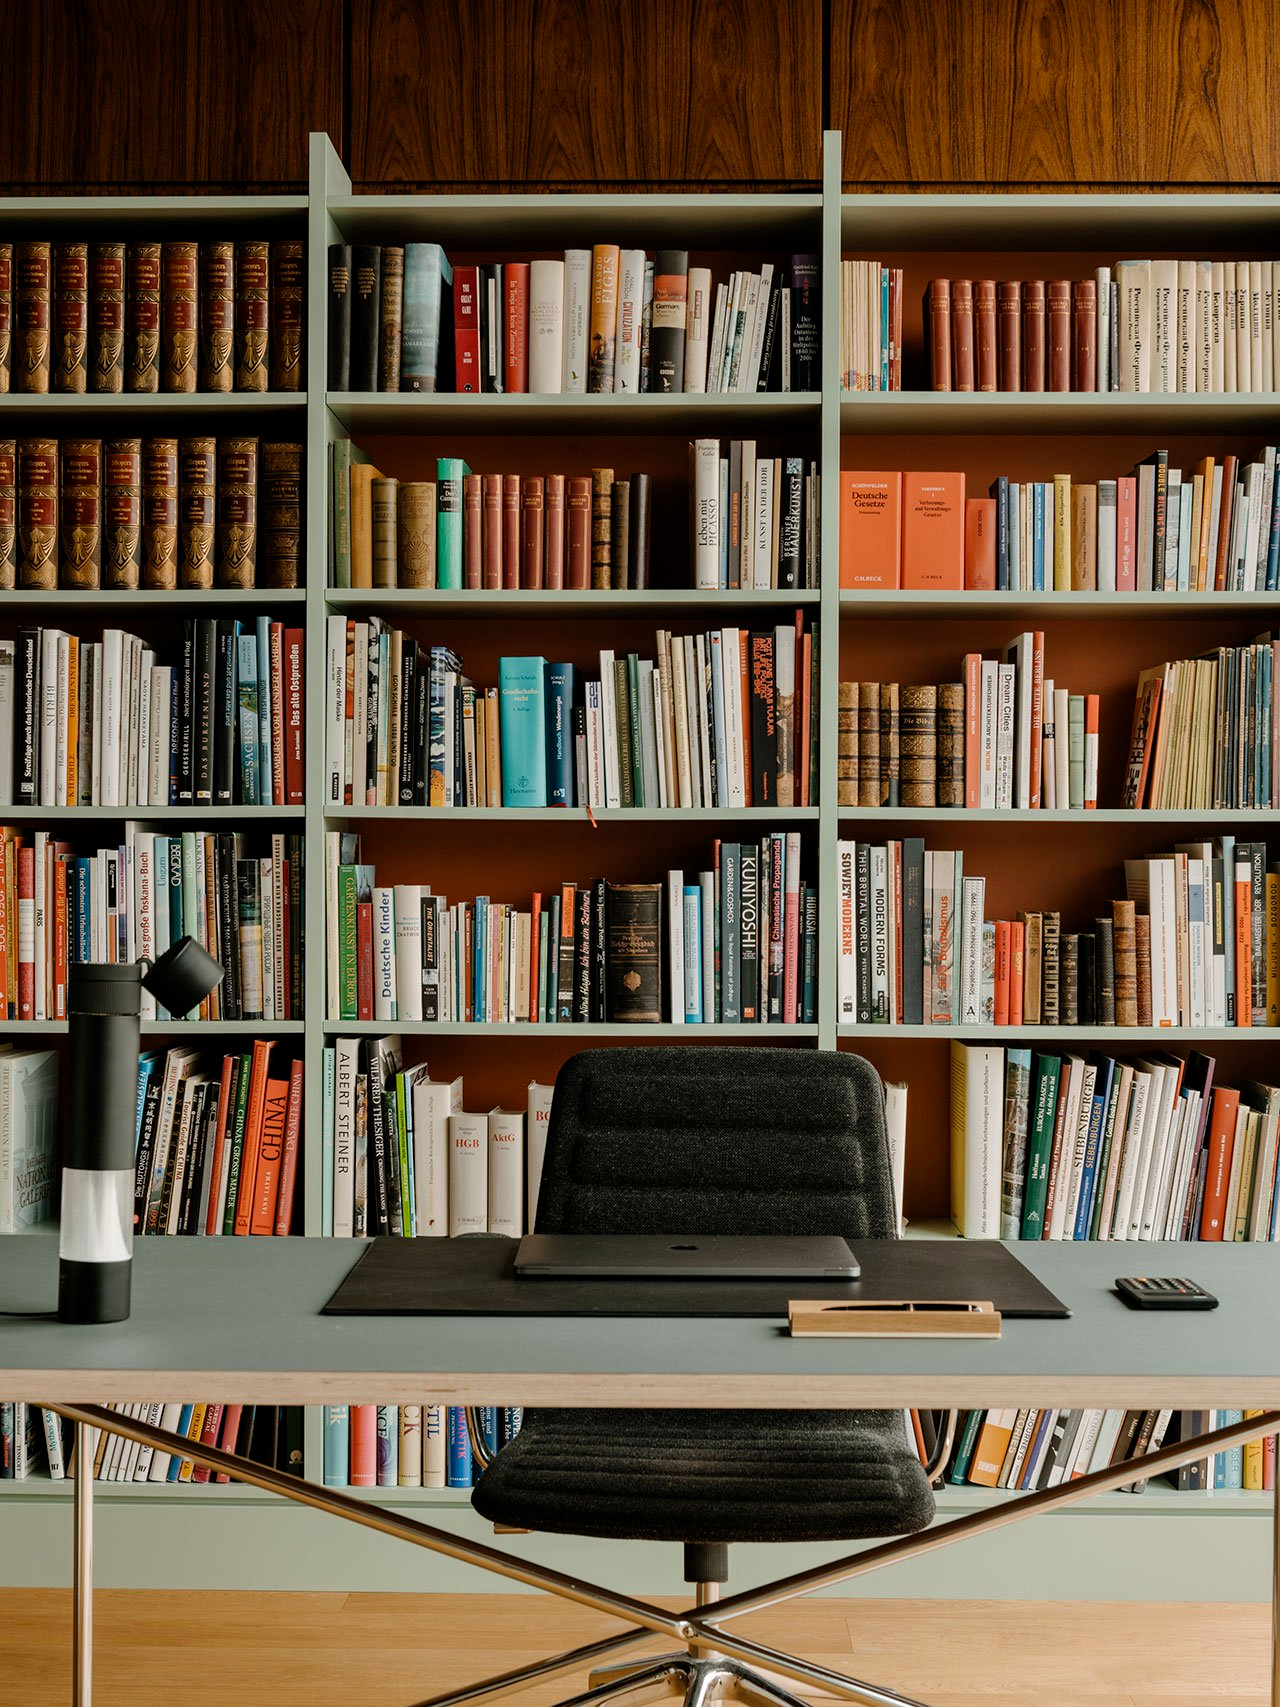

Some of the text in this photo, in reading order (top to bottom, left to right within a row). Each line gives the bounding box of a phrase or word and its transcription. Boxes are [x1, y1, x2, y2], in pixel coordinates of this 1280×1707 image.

[508, 289, 517, 305] Troja
[602, 256, 615, 303] FIGES
[622, 302, 633, 343] CIVILIZATION
[1212, 292, 1221, 343] Белоруссия
[1133, 341, 1142, 392] Федерация
[699, 517, 708, 546] Leben
[708, 499, 717, 546] PICASSO
[760, 508, 766, 518] IN
[790, 476, 801, 557] MAUERKUNST
[1157, 496, 1165, 525] BILLING
[1123, 545, 1131, 560] Ruge
[184, 658, 190, 667] im
[290, 644, 301, 726] Das alte Ostpreußen
[47, 685, 55, 726] BERLIN
[183, 669, 192, 717] Siebenbürgen
[202, 672, 210, 750] BURZENLAND
[271, 632, 281, 782] HAMBURG VOR HUNDERT JAHREN
[24, 745, 33, 777] Streifzüge
[243, 712, 254, 766] SACHSEN
[157, 856, 168, 887] Ungarn
[170, 844, 182, 886] BELGRAD
[56, 867, 65, 923] Zeit für London
[140, 852, 151, 960] Das große Toskana-Buch
[581, 894, 590, 926] Berliner
[742, 858, 756, 947] KUNIYOSHI
[772, 840, 781, 940] Chinesische Propaganda
[842, 853, 852, 955] SOWJETMODERNE
[859, 850, 868, 953] THIS BRUTAL WORLD
[263, 896, 272, 974] ПРИРОДНЫЕ ЧУДЕСА РОССИИ
[806, 896, 816, 935] HOKUSAI
[876, 889, 886, 976] MODERN FORMS
[346, 877, 357, 1006] GARTENKUNST IN EUROPA
[380, 892, 392, 998] Deutsche Kinder
[581, 942, 589, 954] bin
[581, 957, 589, 967] Ich
[581, 970, 590, 995] Hagen
[580, 997, 589, 1016] Nina
[261, 1096, 286, 1161] CHINA
[285, 1073, 302, 1150] DAS ALTE CHINA
[338, 1053, 350, 1174] ALBERT STEINER
[370, 1057, 384, 1157] WILFRED THESIGER
[1074, 1069, 1096, 1168] SIEBENBÜRGEN
[1132, 1084, 1146, 1136] SIEBENBÜRGEN
[227, 1109, 245, 1208] CHINAS GROSSE MAUER
[455, 1139, 480, 1148] HGB
[491, 1134, 515, 1142] AktG
[1085, 1102, 1102, 1168] SIEBENBÜRGEN
[136, 1150, 148, 1185] HUTONGS
[1032, 1154, 1040, 1178] Hoffmann
[49, 1430, 60, 1452] Mythos
[1008, 1408, 1028, 1454] STORIES
[1017, 1416, 1036, 1461] JOURNEYS
